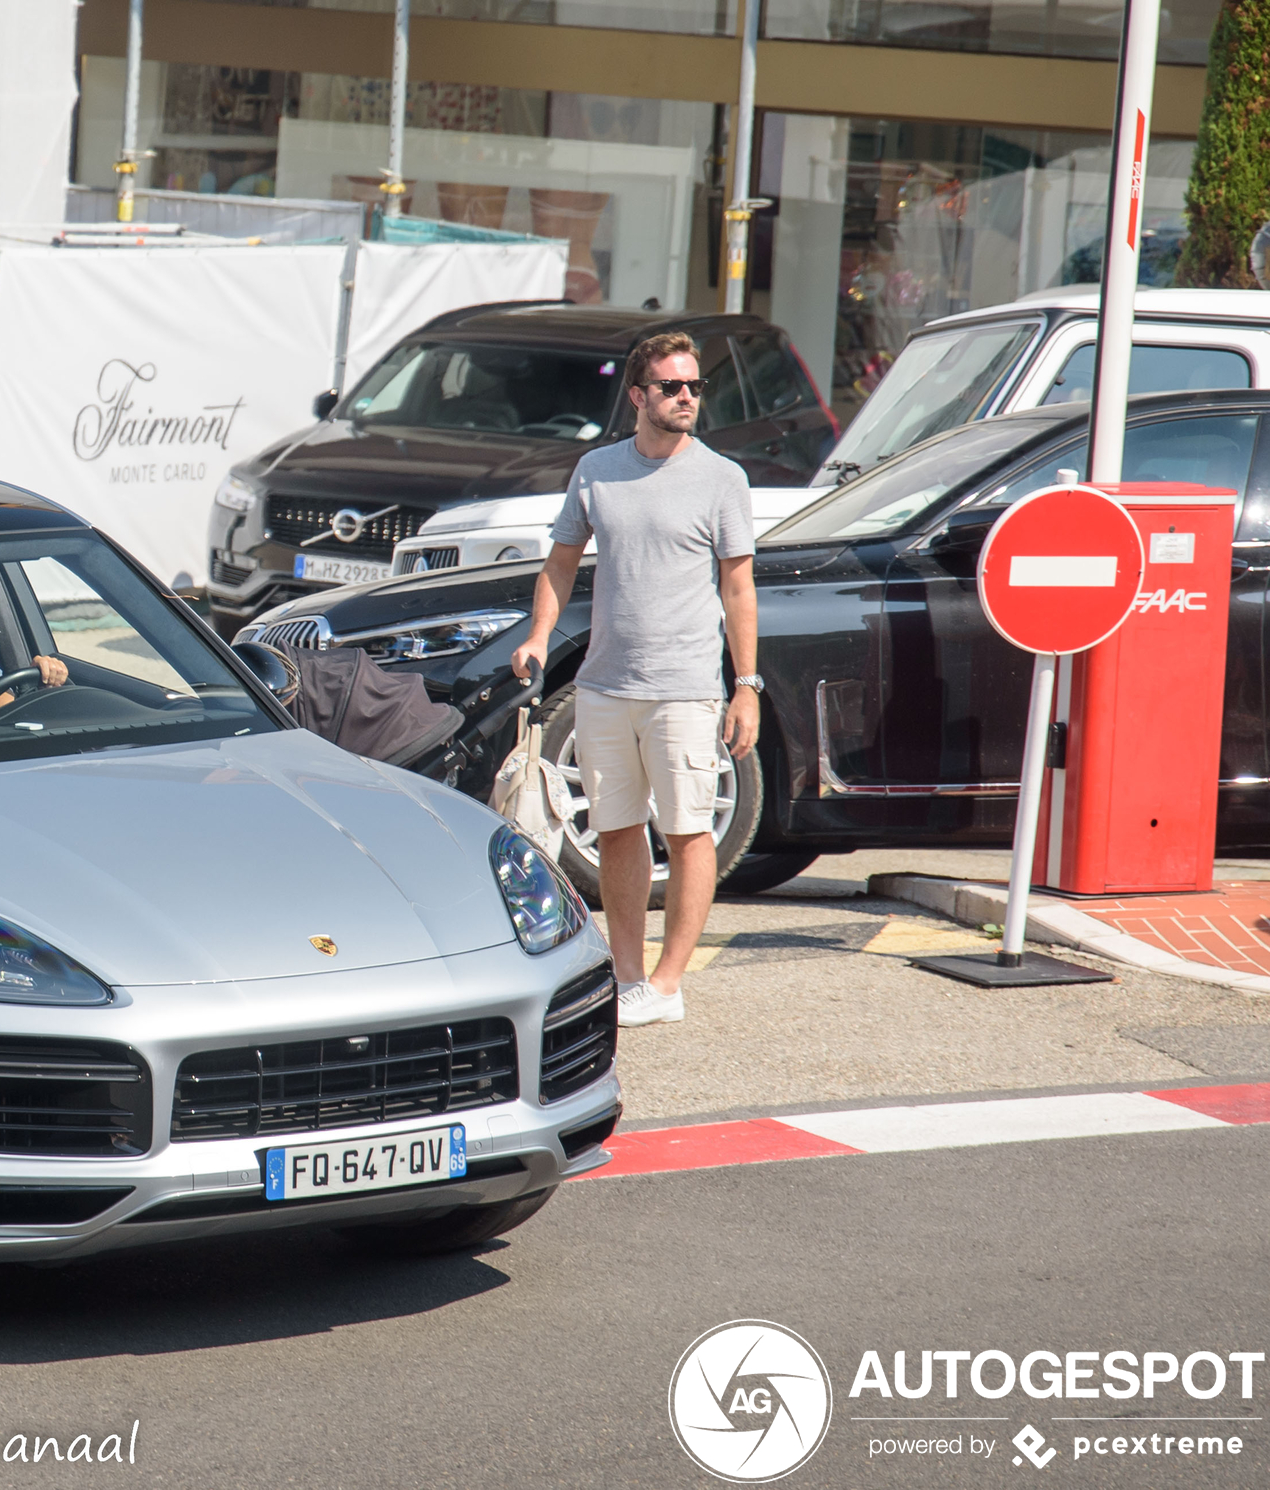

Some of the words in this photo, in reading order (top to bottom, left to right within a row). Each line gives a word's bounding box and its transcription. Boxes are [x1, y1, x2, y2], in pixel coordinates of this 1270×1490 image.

[73, 359, 247, 461] Fairmont
[109, 463, 157, 484] MONTE
[163, 462, 206, 483] CARLO
[1131, 588, 1208, 613] FAAC
[272, 1178, 279, 1190] F
[291, 1137, 444, 1189] FQ-647-QV
[450, 1153, 466, 1172] 69
